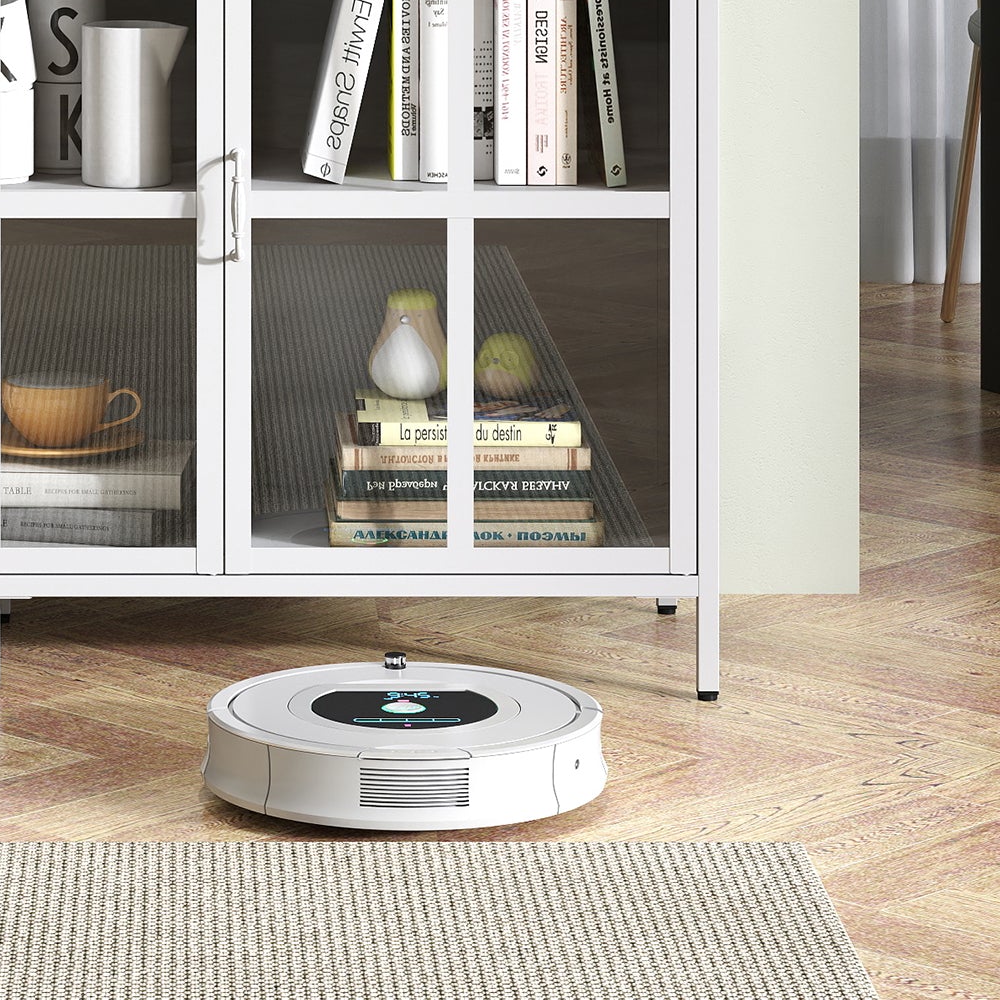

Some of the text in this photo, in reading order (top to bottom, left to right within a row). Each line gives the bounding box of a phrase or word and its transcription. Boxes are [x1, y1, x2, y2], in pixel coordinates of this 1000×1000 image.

[48, 7, 79, 76] S
[400, 423, 410, 441] La
[415, 424, 447, 444] persist
[476, 423, 488, 441] du
[492, 423, 522, 441] destin
[3, 486, 32, 495] TABLE
[474, 531, 504, 540] ЛОК
[517, 531, 586, 541] ПОЭМЫ
